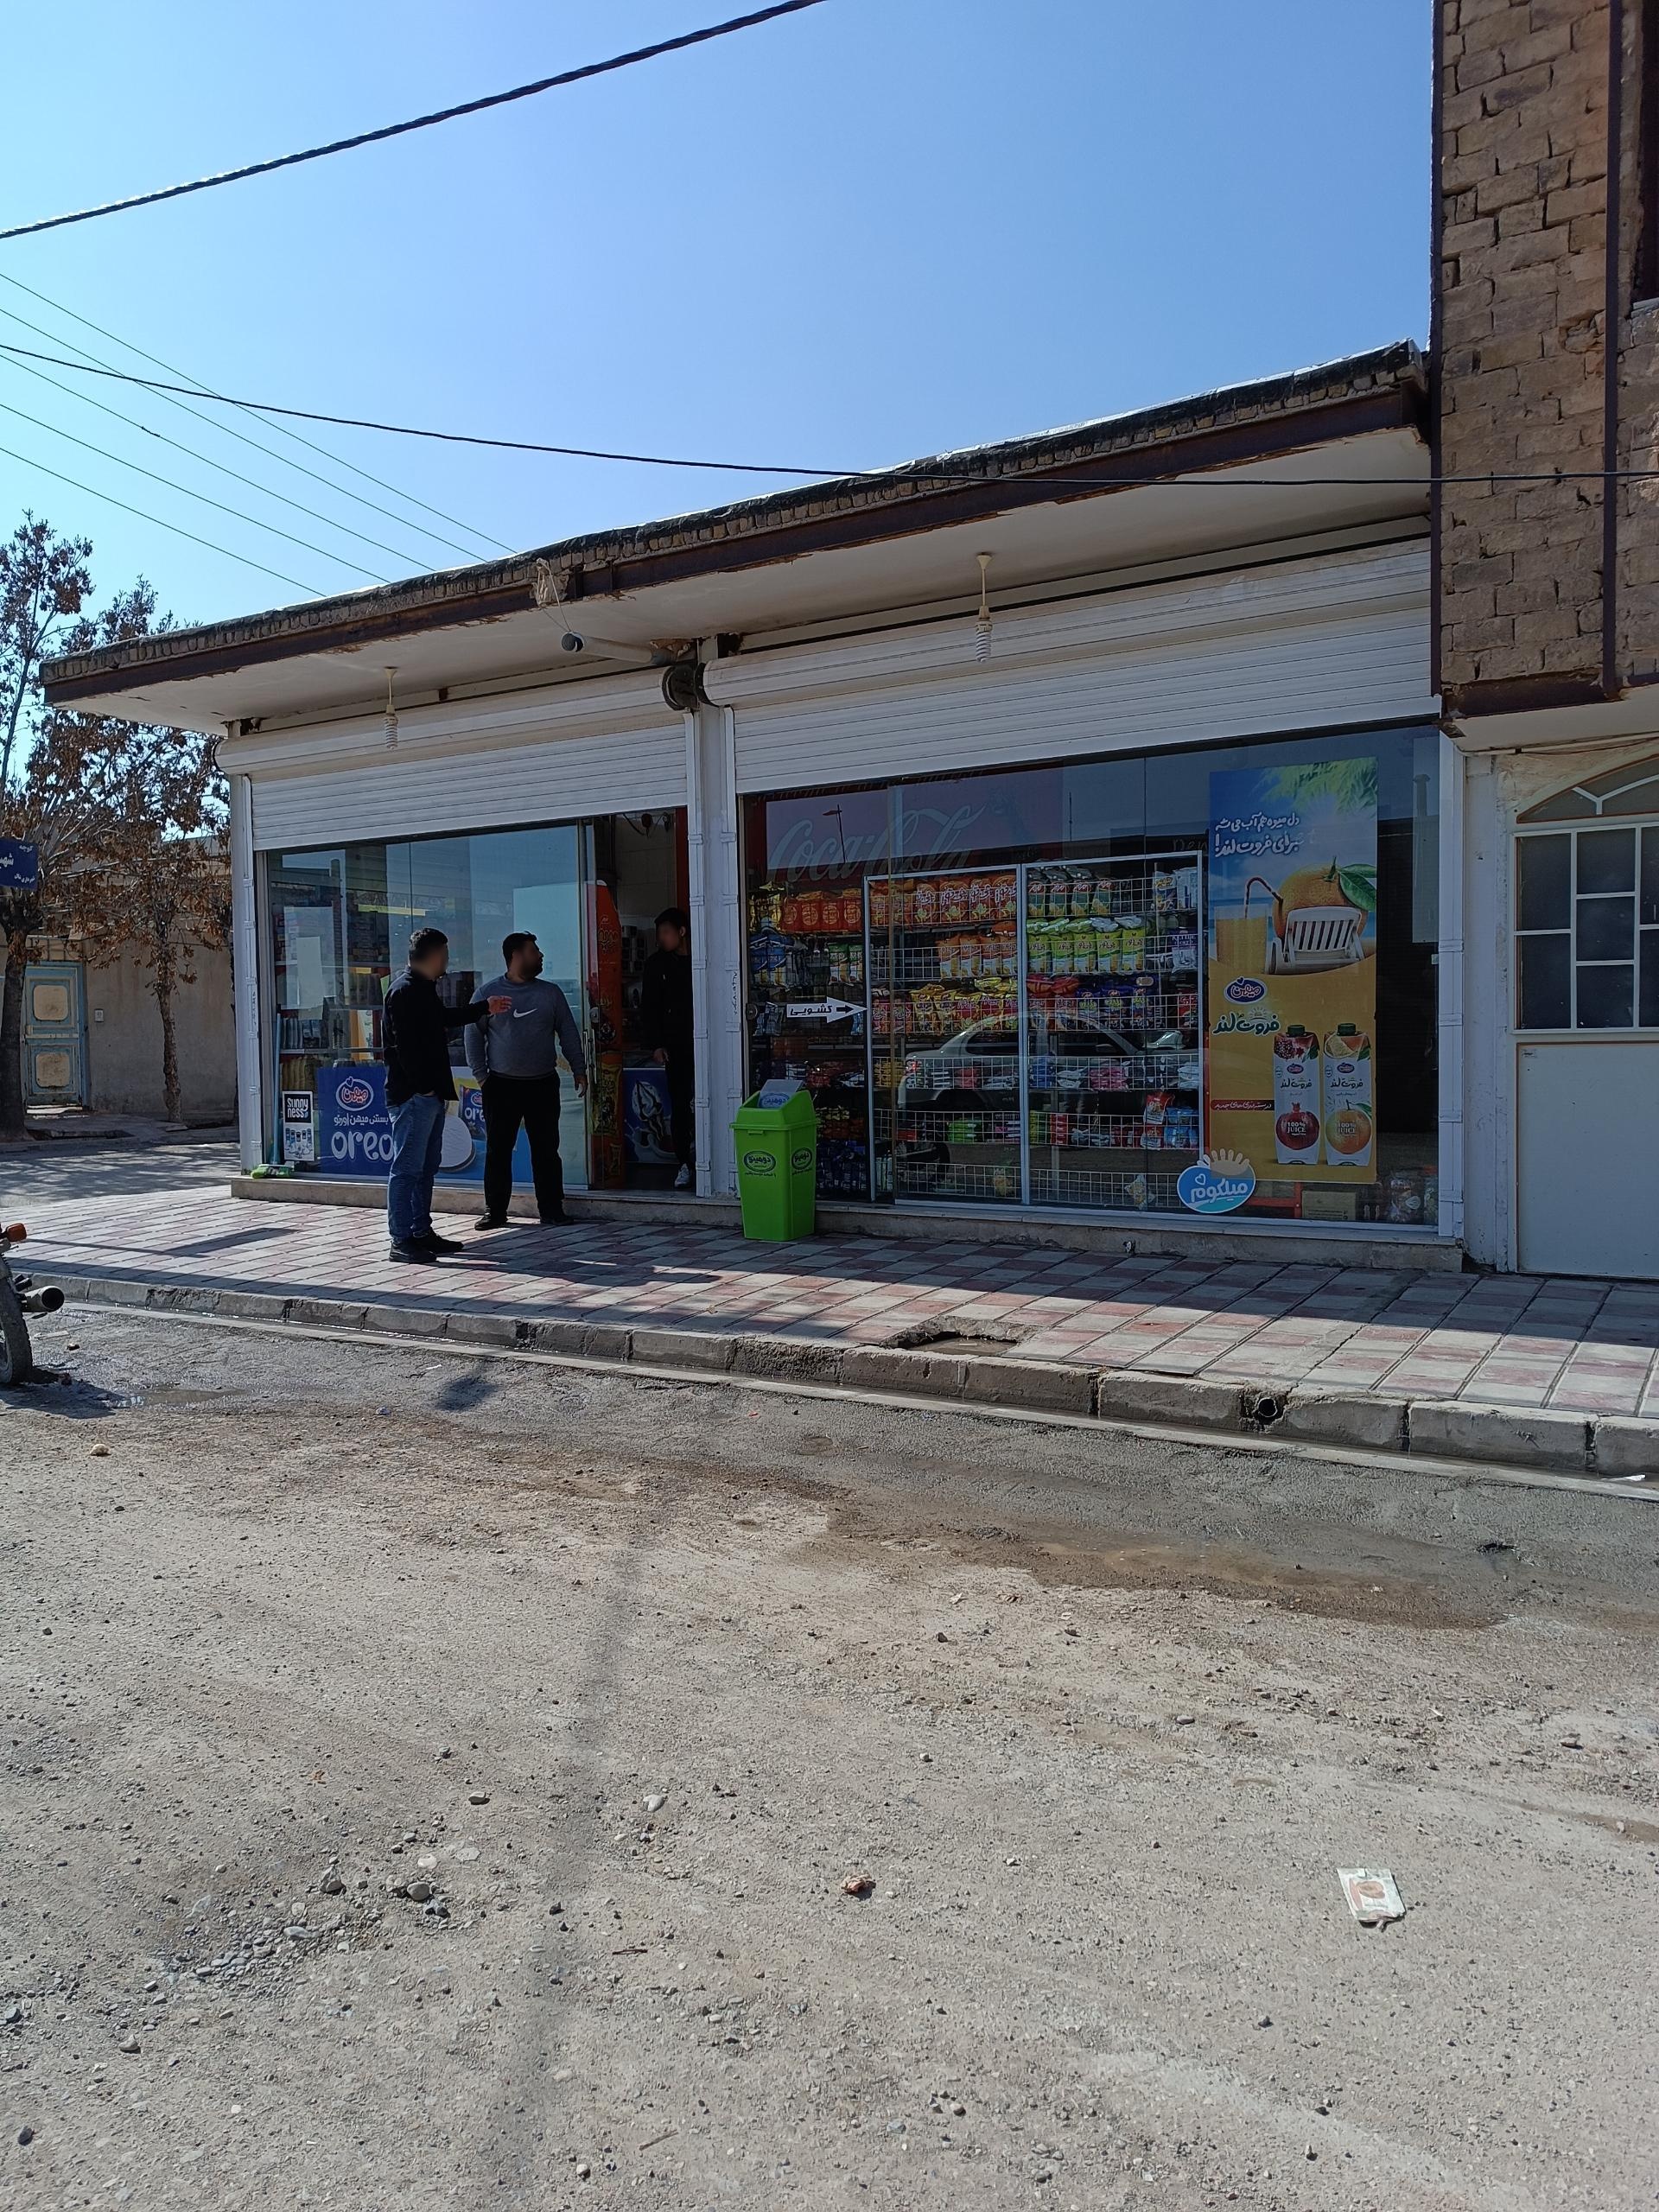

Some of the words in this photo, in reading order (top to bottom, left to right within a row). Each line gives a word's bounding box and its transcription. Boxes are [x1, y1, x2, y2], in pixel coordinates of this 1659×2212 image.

[1242, 812, 1262, 830] آب
[1257, 815, 1267, 832] هم
[1267, 817, 1287, 830] میوه
[1287, 813, 1300, 826] دل
[1236, 835, 1272, 856] فروت
[1272, 830, 1303, 855] برای
[1230, 983, 1262, 999] میهن
[791, 1004, 832, 1015] کشویی
[1212, 1012, 1236, 1034] لند
[1236, 1014, 1281, 1034] فروت
[341, 1086, 369, 1104] میهن
[287, 1097, 308, 1112] Sunny
[287, 1108, 304, 1119] ness
[350, 1116, 369, 1126] میهن
[464, 1107, 486, 1122] ore
[331, 1131, 394, 1161] oreo
[748, 1154, 771, 1164] دومینو
[1191, 1178, 1249, 1203] میلکوم
